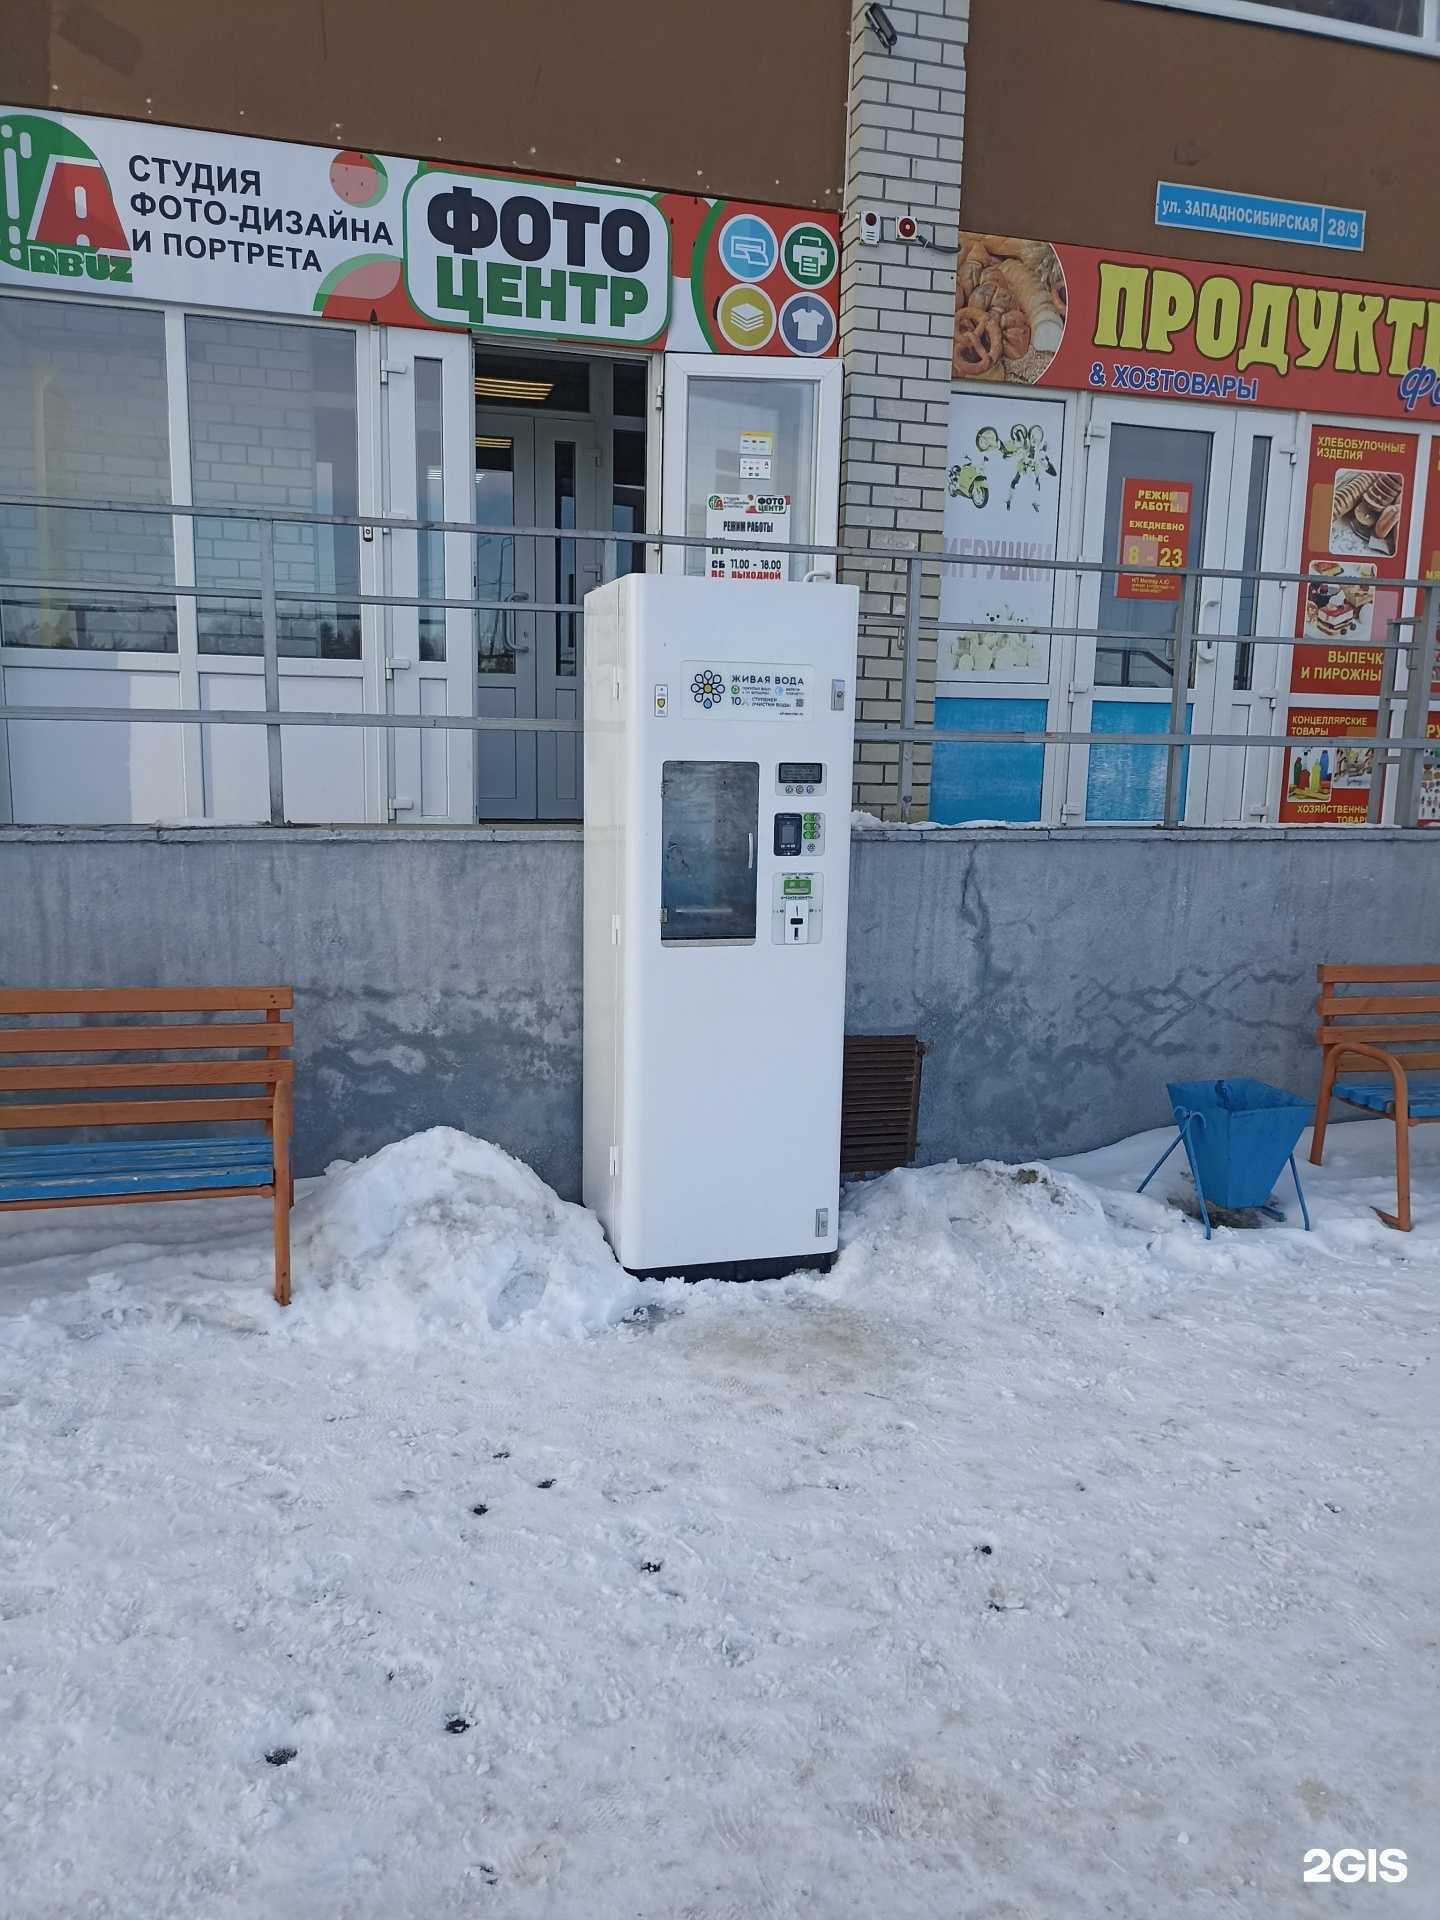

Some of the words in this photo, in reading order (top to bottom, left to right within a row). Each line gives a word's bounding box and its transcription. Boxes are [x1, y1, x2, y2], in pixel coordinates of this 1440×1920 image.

[129, 154, 261, 196] СТУДИЯ
[130, 191, 393, 246] ФОТО-ДИЗАЙНА
[1162, 200, 1181, 216] ул.
[1184, 200, 1319, 233] ЗАПАДНОСИБИРСКАЯ
[1327, 217, 1359, 240] 28/9
[427, 186, 650, 273] ФОТО
[132, 228, 151, 253] И
[163, 231, 323, 273] ПОРТРЕТА
[436, 255, 648, 328] ЦЕНТР
[1089, 362, 1106, 386] &
[1112, 364, 1258, 401] ХОЗТОВАРЫ
[1399, 366, 1440, 411] Ф
[1317, 435, 1406, 454] ХЛЕБОБУЛОЧНЫЕ
[1316, 448, 1363, 461] ИЗДЕЛИЯ
[757, 497, 784, 505] ФОТО
[1138, 489, 1179, 500] РЕЖИМ
[1134, 500, 1184, 513] РАБОТЫ
[723, 520, 746, 532] РЕЖИМ
[747, 521, 774, 533] РАБОТЫ
[1129, 520, 1185, 531] ЕЖЕДНЕВНО
[1159, 547, 1183, 568] 23
[711, 560, 726, 569] СБ
[760, 560, 782, 570] 18.00
[731, 570, 781, 580] ВЫХОДНОЙ
[1327, 650, 1384, 665] ВЫПЕЧК
[731, 674, 771, 684] ЖИВАЯ
[774, 676, 804, 685] ВОДА
[1300, 667, 1310, 679] И
[1313, 667, 1382, 682] ПИРОЖНЫ
[730, 696, 742, 706] 10
[1292, 715, 1368, 727] КОНЦЕЛЛЯРСКИЕ
[1291, 727, 1329, 736] ТОВАРЫ
[1297, 803, 1369, 814] ХОЗЯЙСТВЕННЫ
